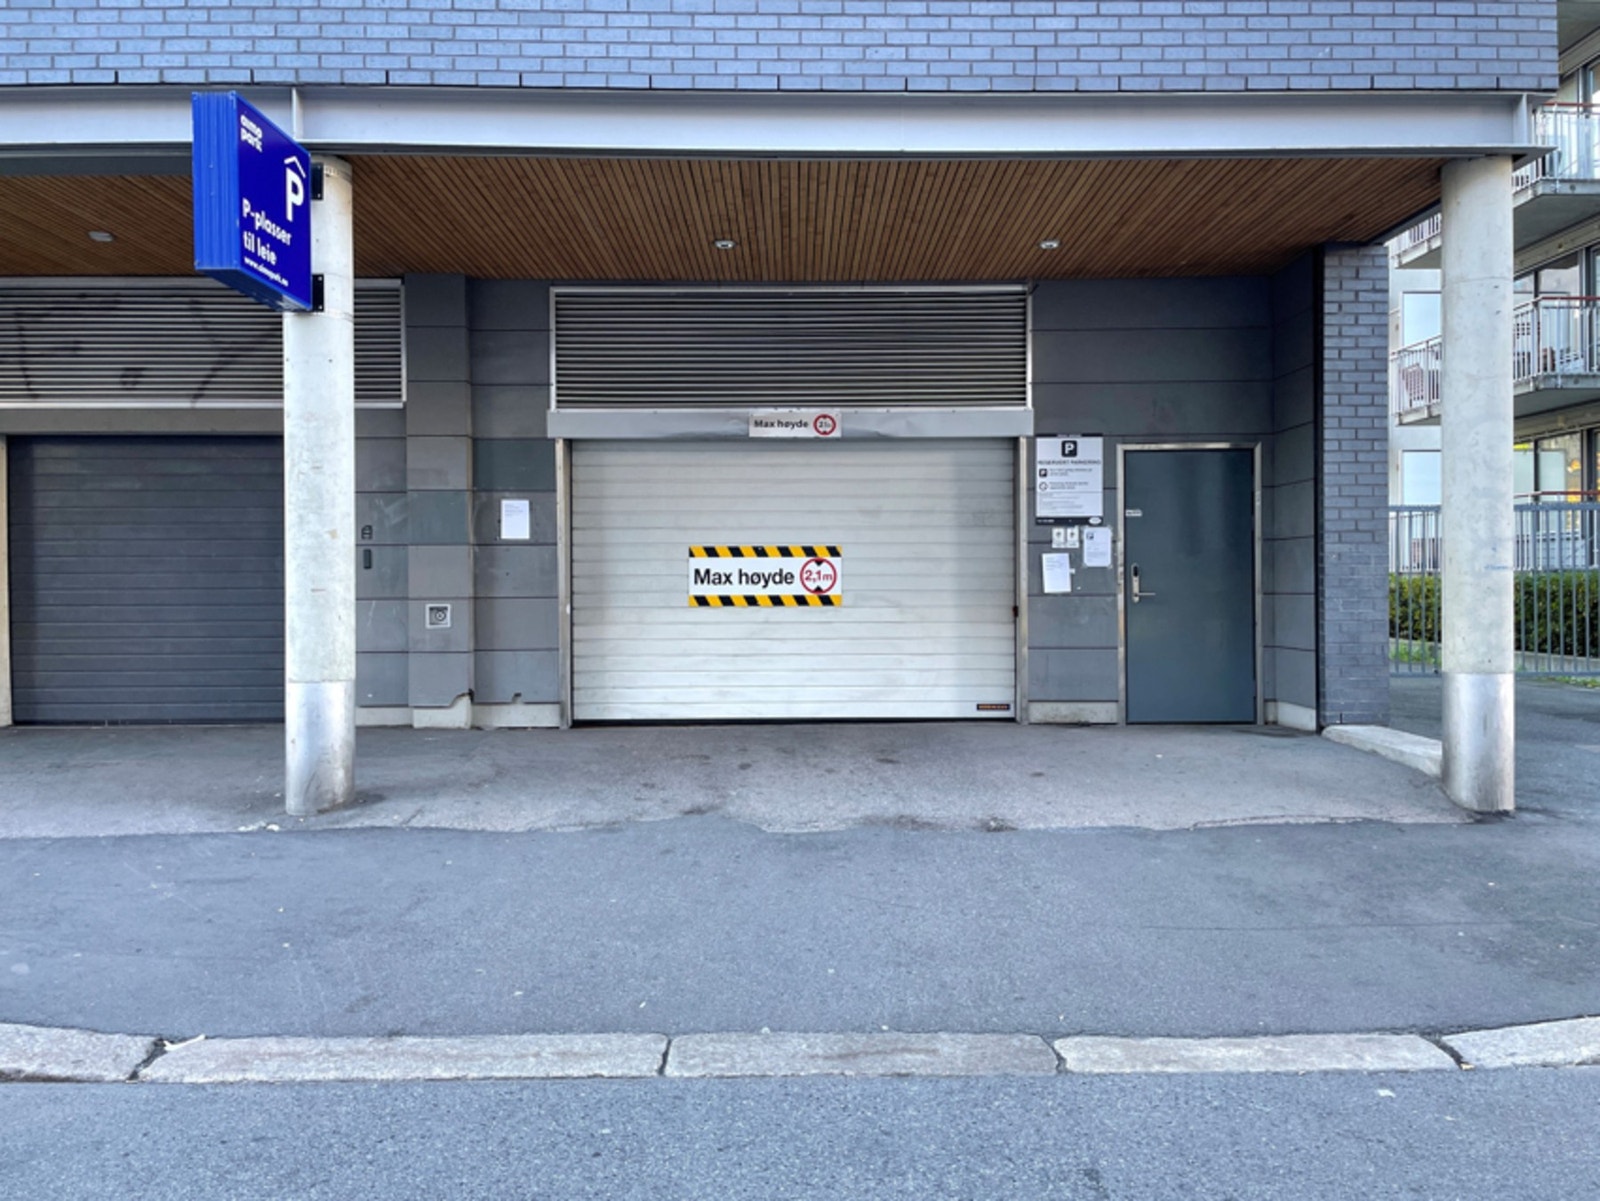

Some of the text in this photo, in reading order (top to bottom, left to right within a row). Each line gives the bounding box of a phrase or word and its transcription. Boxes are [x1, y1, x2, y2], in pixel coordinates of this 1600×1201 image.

[286, 167, 304, 223] P
[242, 197, 292, 246] P-plasser
[243, 231, 278, 266] til leie
[754, 419, 776, 429] Max
[777, 419, 809, 430] høyde
[1064, 442, 1075, 455] P
[694, 567, 733, 586] Max
[738, 567, 795, 589] høyde
